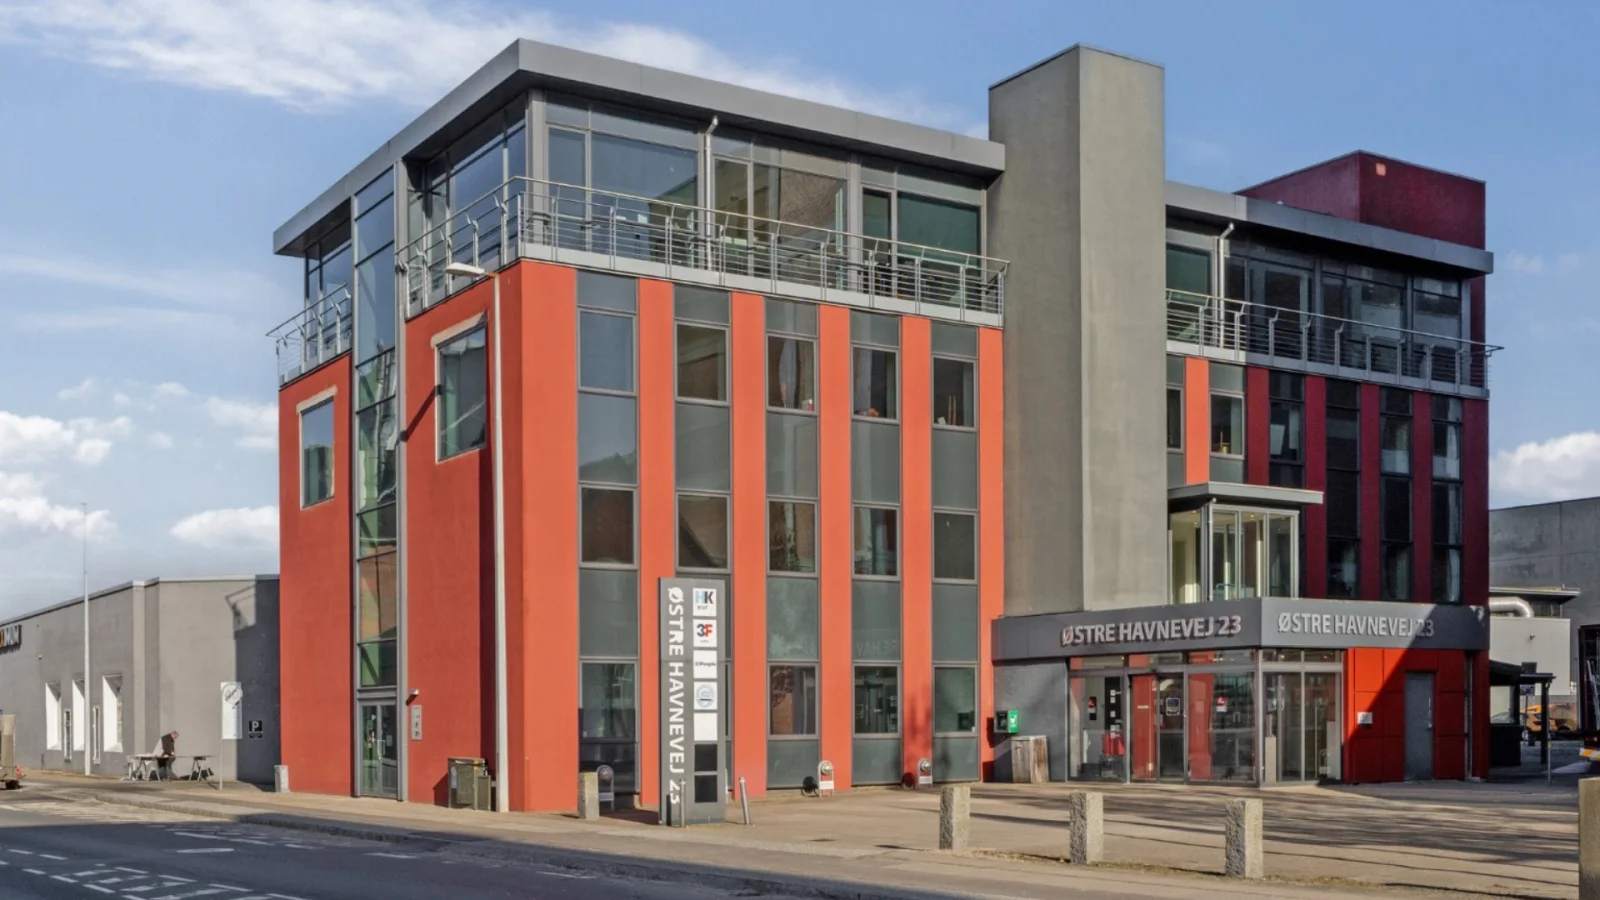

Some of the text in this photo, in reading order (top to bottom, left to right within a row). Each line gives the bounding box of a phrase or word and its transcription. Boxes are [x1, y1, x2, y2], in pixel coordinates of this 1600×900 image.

[695, 590, 714, 604] HK
[696, 623, 713, 637] 3F
[1061, 615, 1242, 646] ØSTRE HAVNEVEJ 23
[1278, 612, 1435, 637] ØSTRE HAVNEVEJ 23
[668, 587, 685, 804] ØSTRE HAVNEVEJ 23
[252, 720, 259, 732] P
